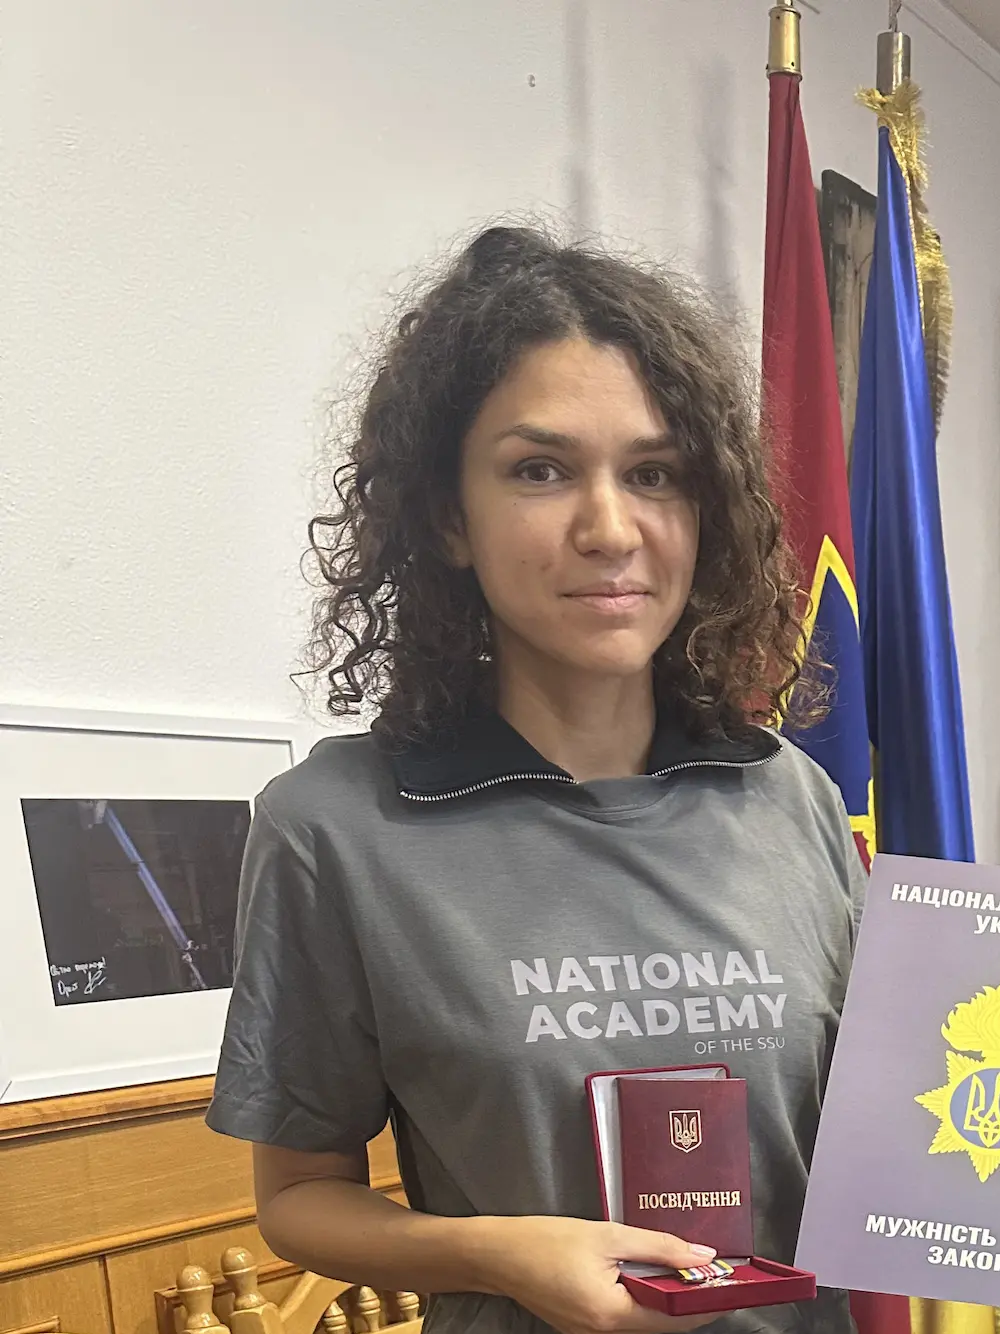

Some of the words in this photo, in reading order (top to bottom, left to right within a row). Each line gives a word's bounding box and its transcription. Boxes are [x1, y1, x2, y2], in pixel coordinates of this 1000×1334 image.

[510, 950, 785, 996] NATIONAL
[525, 993, 788, 1043] ACADEMY
[694, 1040, 716, 1055] OF
[721, 1037, 754, 1052] THE
[757, 1036, 786, 1050] SSU
[638, 1189, 742, 1213] ПОСВІДЧЕННЯ
[865, 1214, 997, 1247] МУЖНІСТЬ
